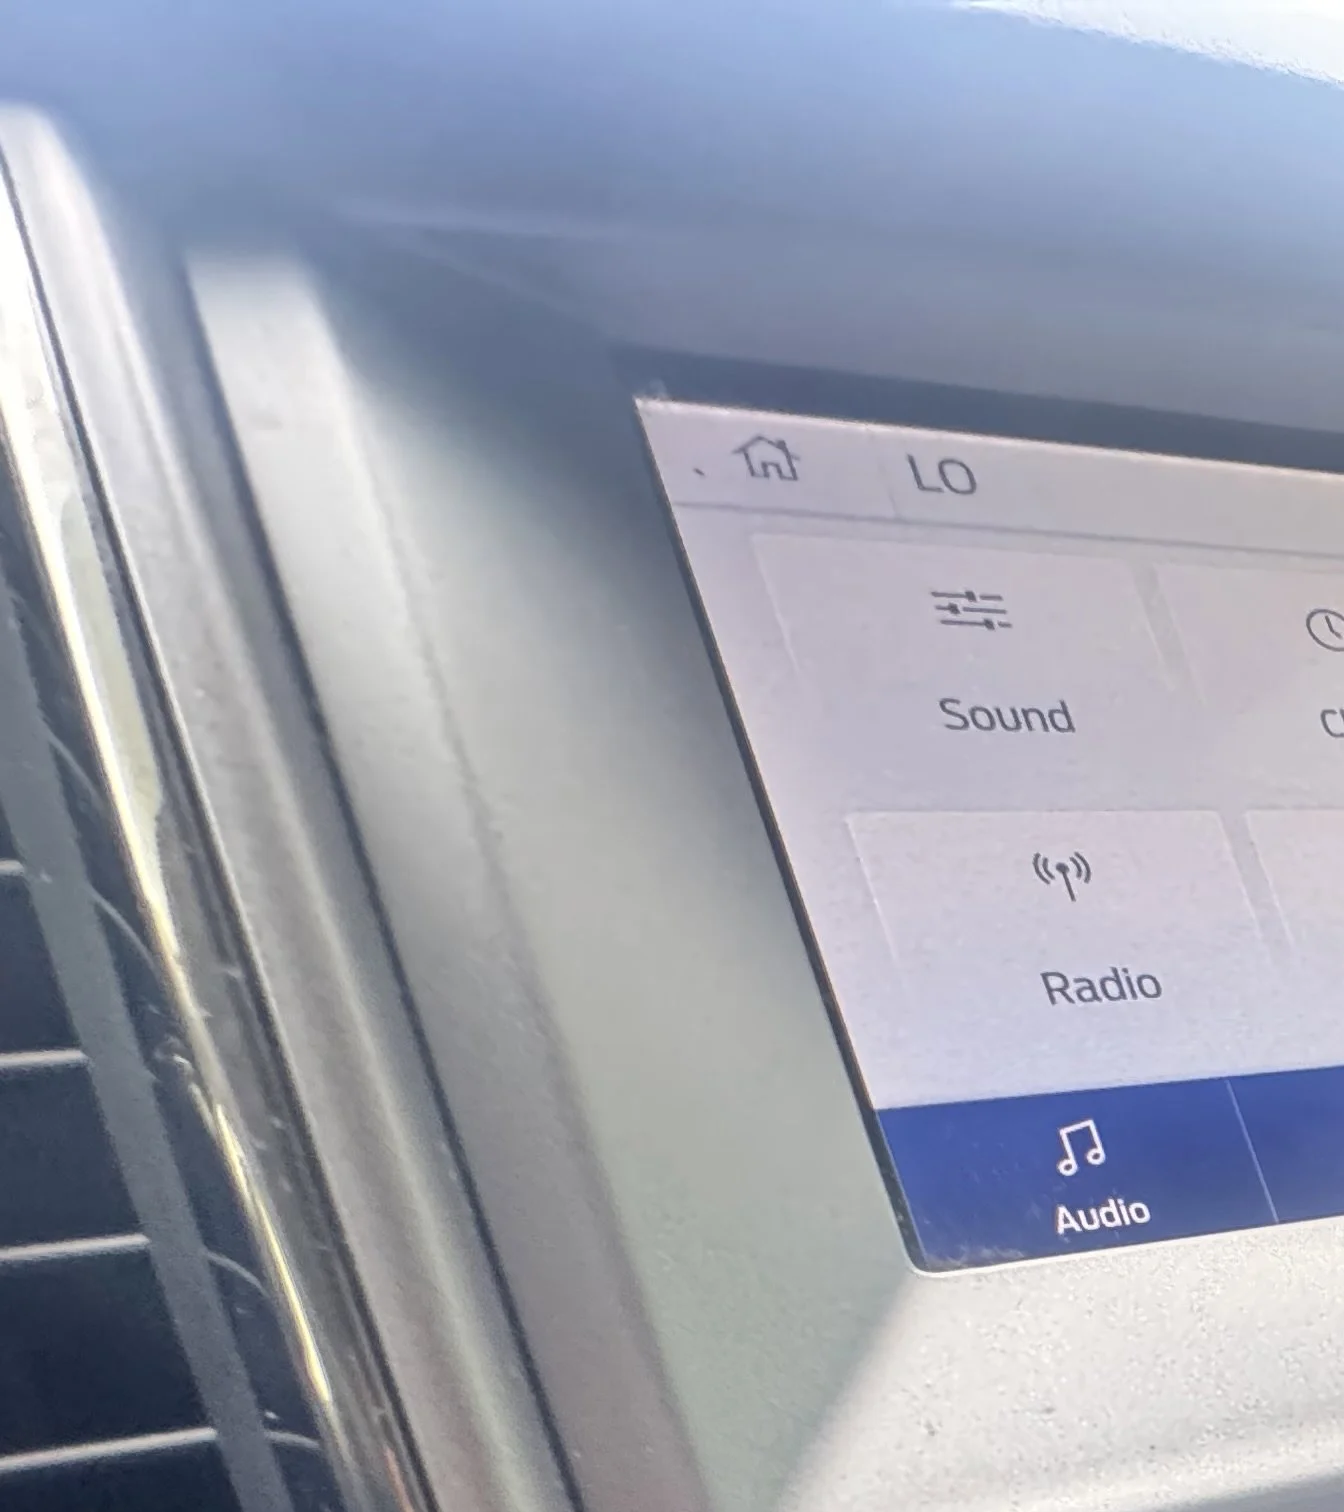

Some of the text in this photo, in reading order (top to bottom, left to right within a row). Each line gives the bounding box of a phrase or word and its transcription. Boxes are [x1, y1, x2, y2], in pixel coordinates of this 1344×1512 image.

[907, 454, 979, 497] LO
[939, 697, 1076, 735] Sound
[1040, 966, 1163, 1006] Radio
[1055, 1197, 1151, 1235] Audio
